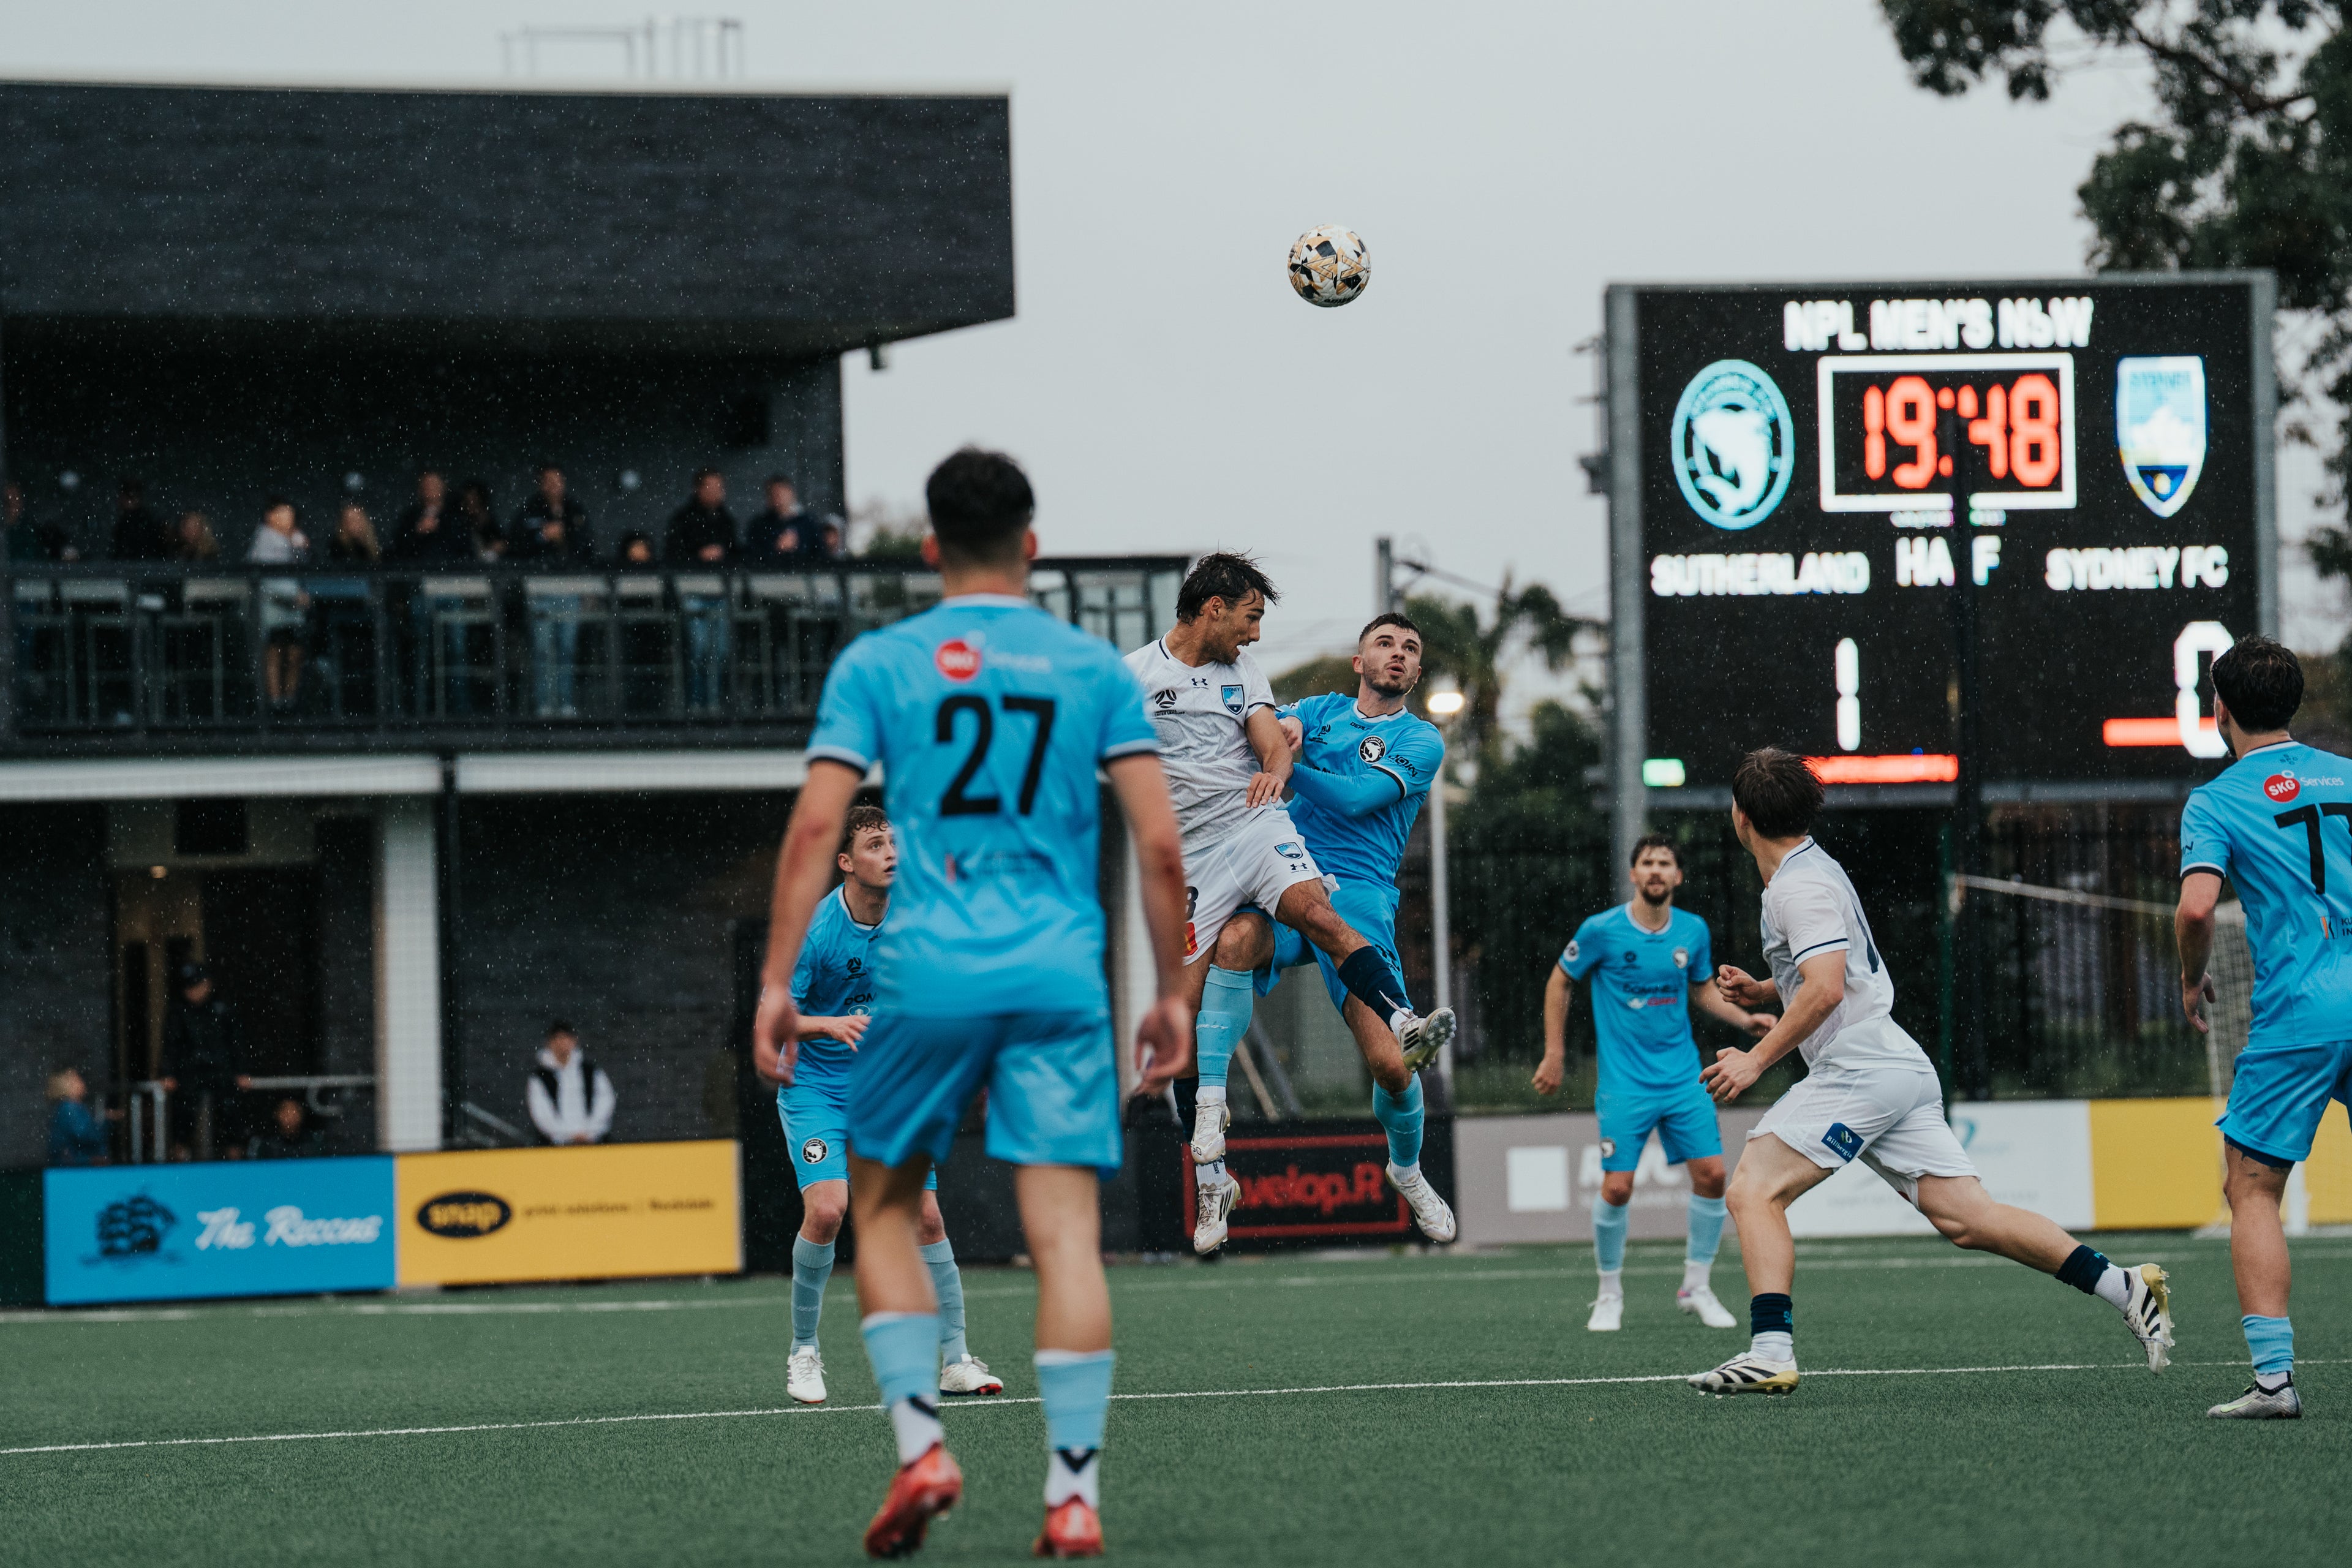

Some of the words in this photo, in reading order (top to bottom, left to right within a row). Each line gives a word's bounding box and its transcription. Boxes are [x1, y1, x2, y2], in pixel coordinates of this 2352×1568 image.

[1783, 300, 1868, 351] NPL
[1869, 298, 1994, 350] MEN'S
[1998, 296, 2094, 349] NSW
[1651, 552, 1870, 596] SUTHERLAND
[1896, 535, 2002, 586] HAF
[2045, 546, 2180, 590] SYDNEY
[2181, 545, 2229, 588] FC
[1835, 638, 1861, 752] 1
[936, 693, 1056, 816] 27
[1388, 754, 1419, 778] JOIN
[2268, 779, 2296, 796] SKG
[2300, 775, 2345, 786] Services
[1826, 1135, 1853, 1159] Billbergia
